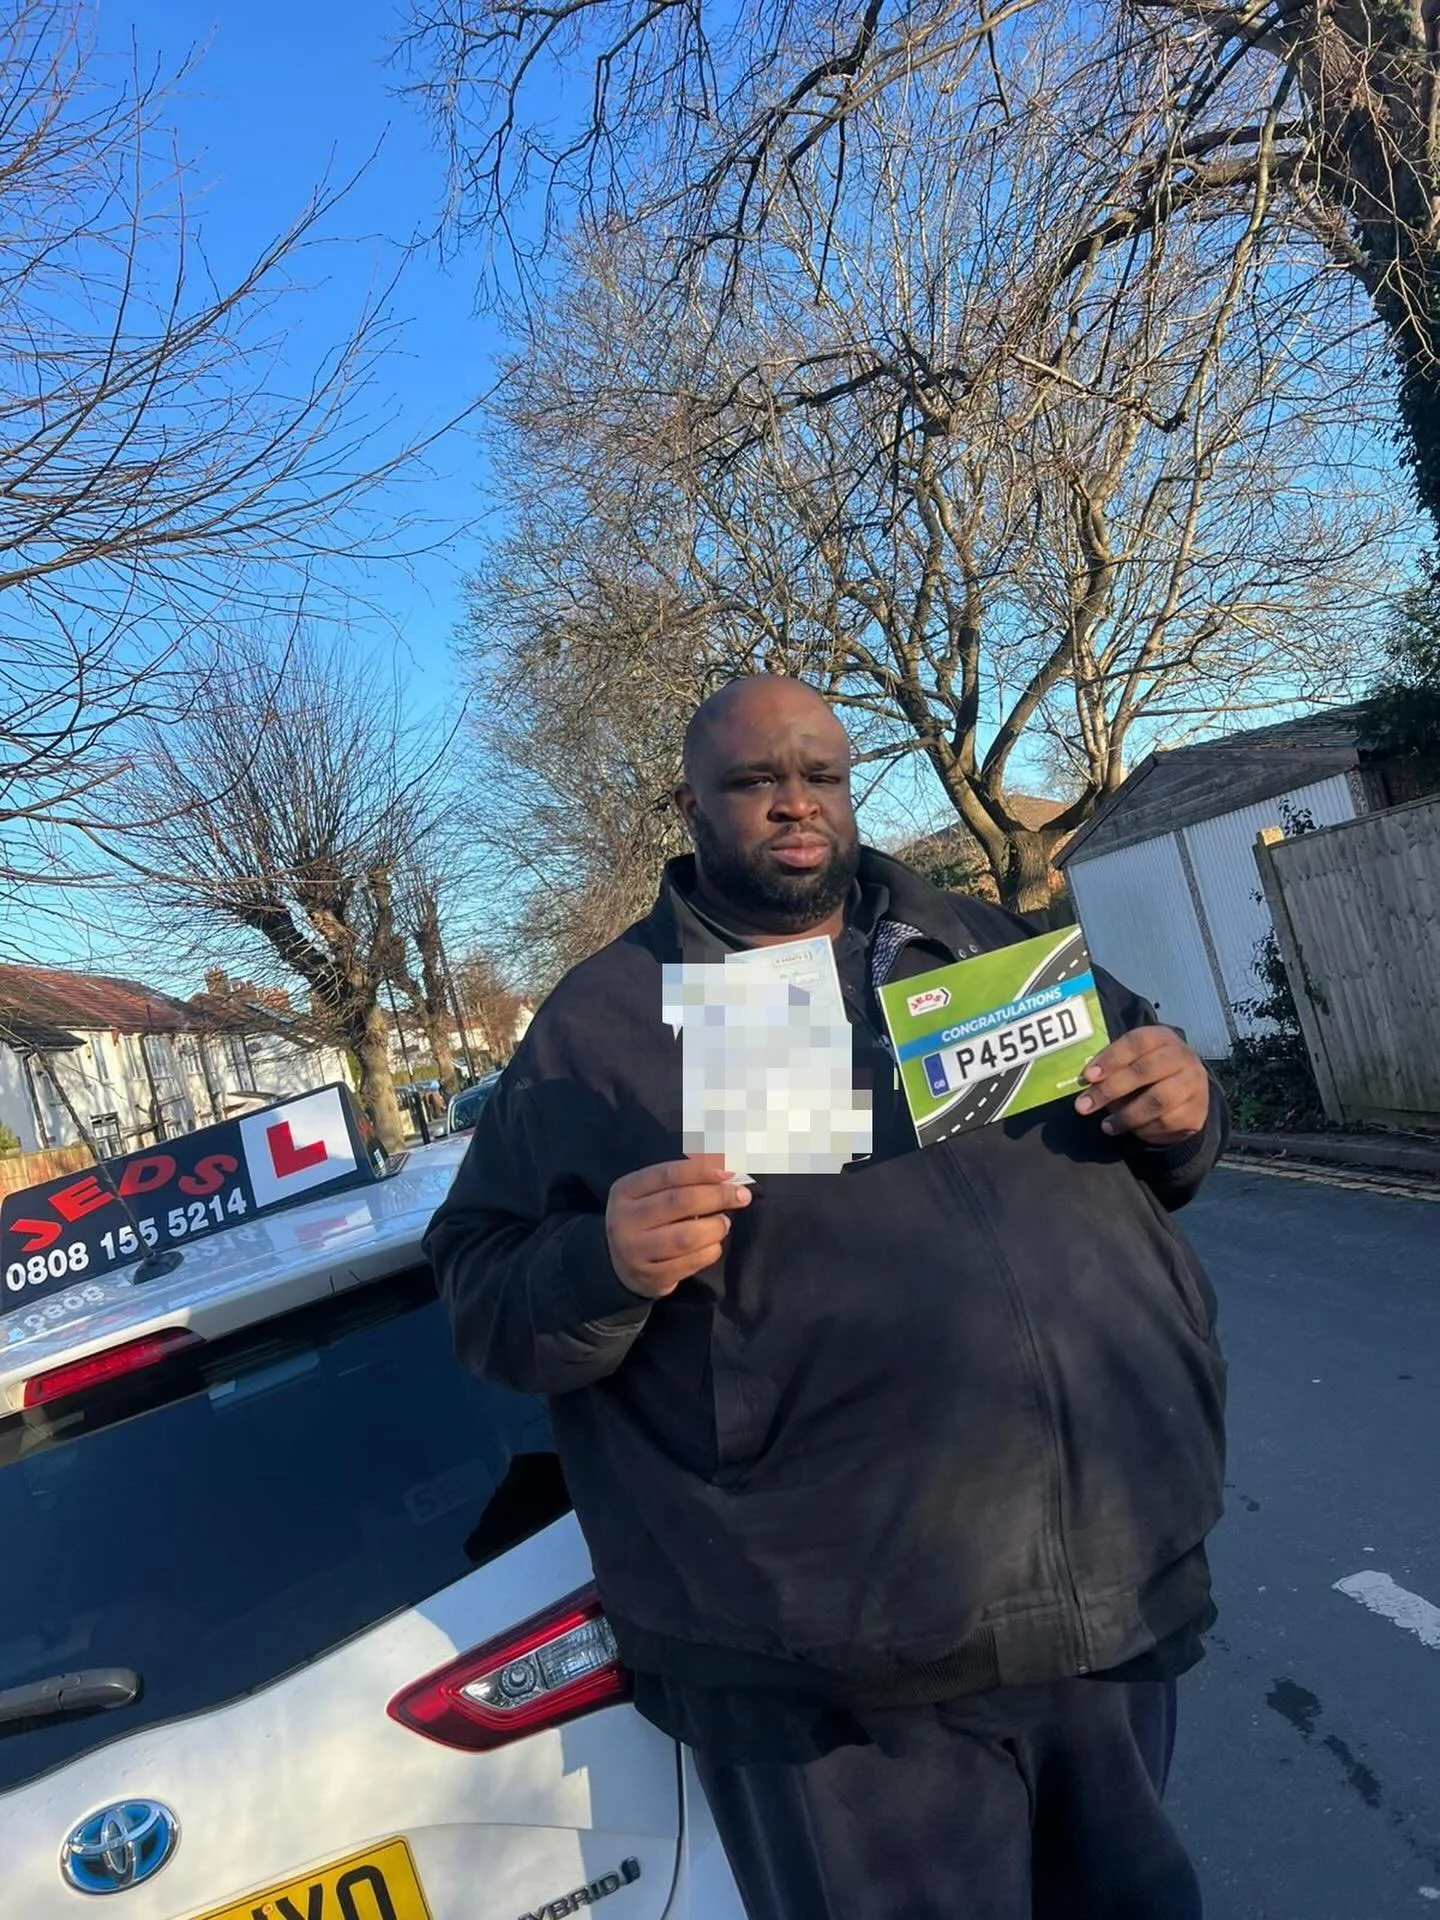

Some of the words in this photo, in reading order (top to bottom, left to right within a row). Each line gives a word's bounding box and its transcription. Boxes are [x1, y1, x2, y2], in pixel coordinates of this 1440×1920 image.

[941, 988, 1062, 1043] CONGRATULATIONS
[955, 1008, 1078, 1080] P455ED
[266, 1120, 328, 1179] L
[9, 1154, 238, 1252] JEDS
[6, 1241, 89, 1292] 0808
[99, 1217, 159, 1260] 155
[167, 1187, 247, 1238] 5214
